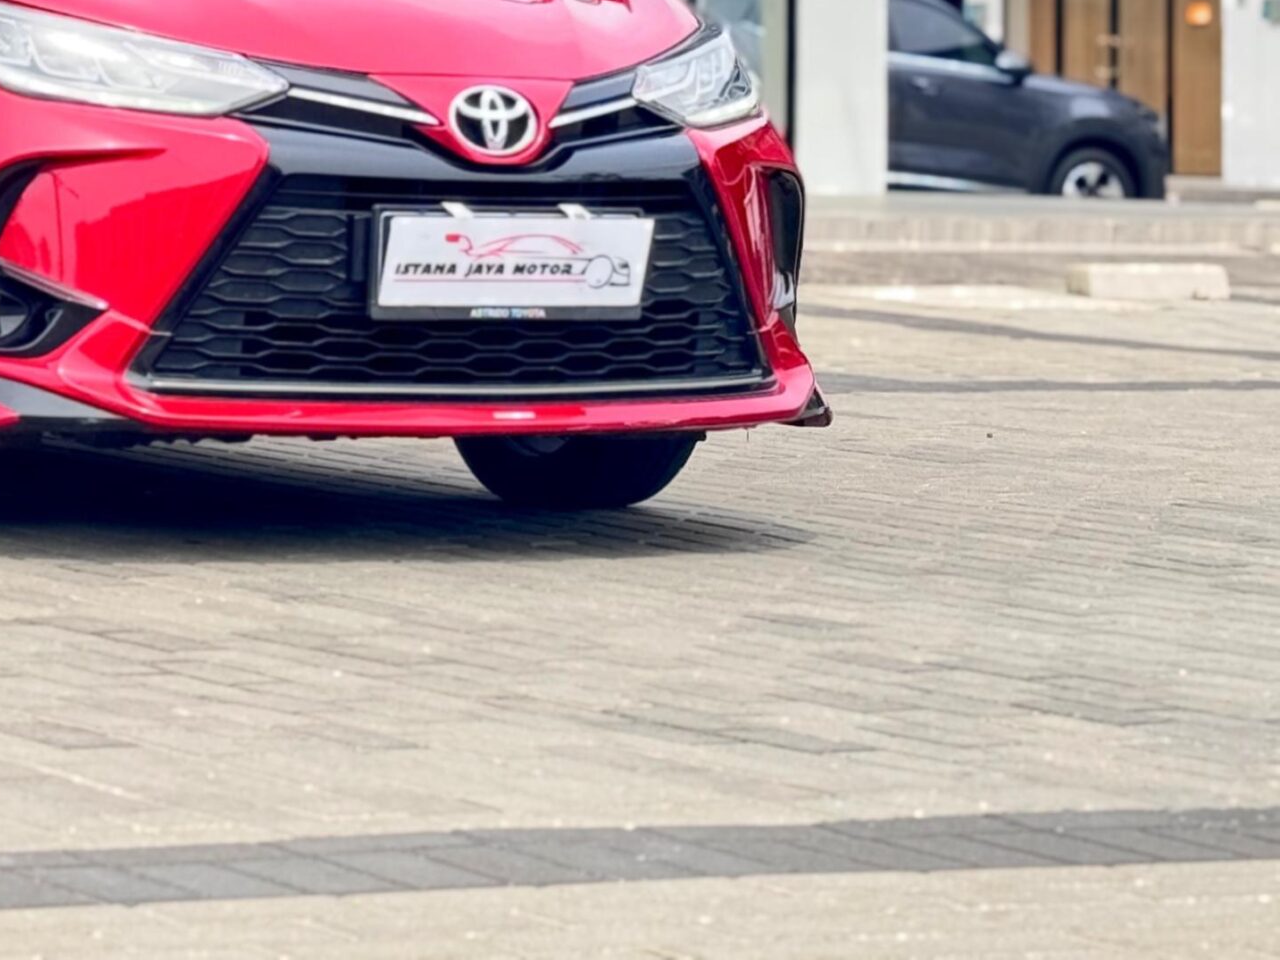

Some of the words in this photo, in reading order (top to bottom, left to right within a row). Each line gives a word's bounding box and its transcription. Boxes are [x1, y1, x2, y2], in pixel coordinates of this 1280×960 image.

[395, 262, 457, 276] ISTANA
[464, 262, 505, 278] JAYA
[512, 263, 573, 276] MOTOR
[511, 307, 546, 319] TOYOTA
